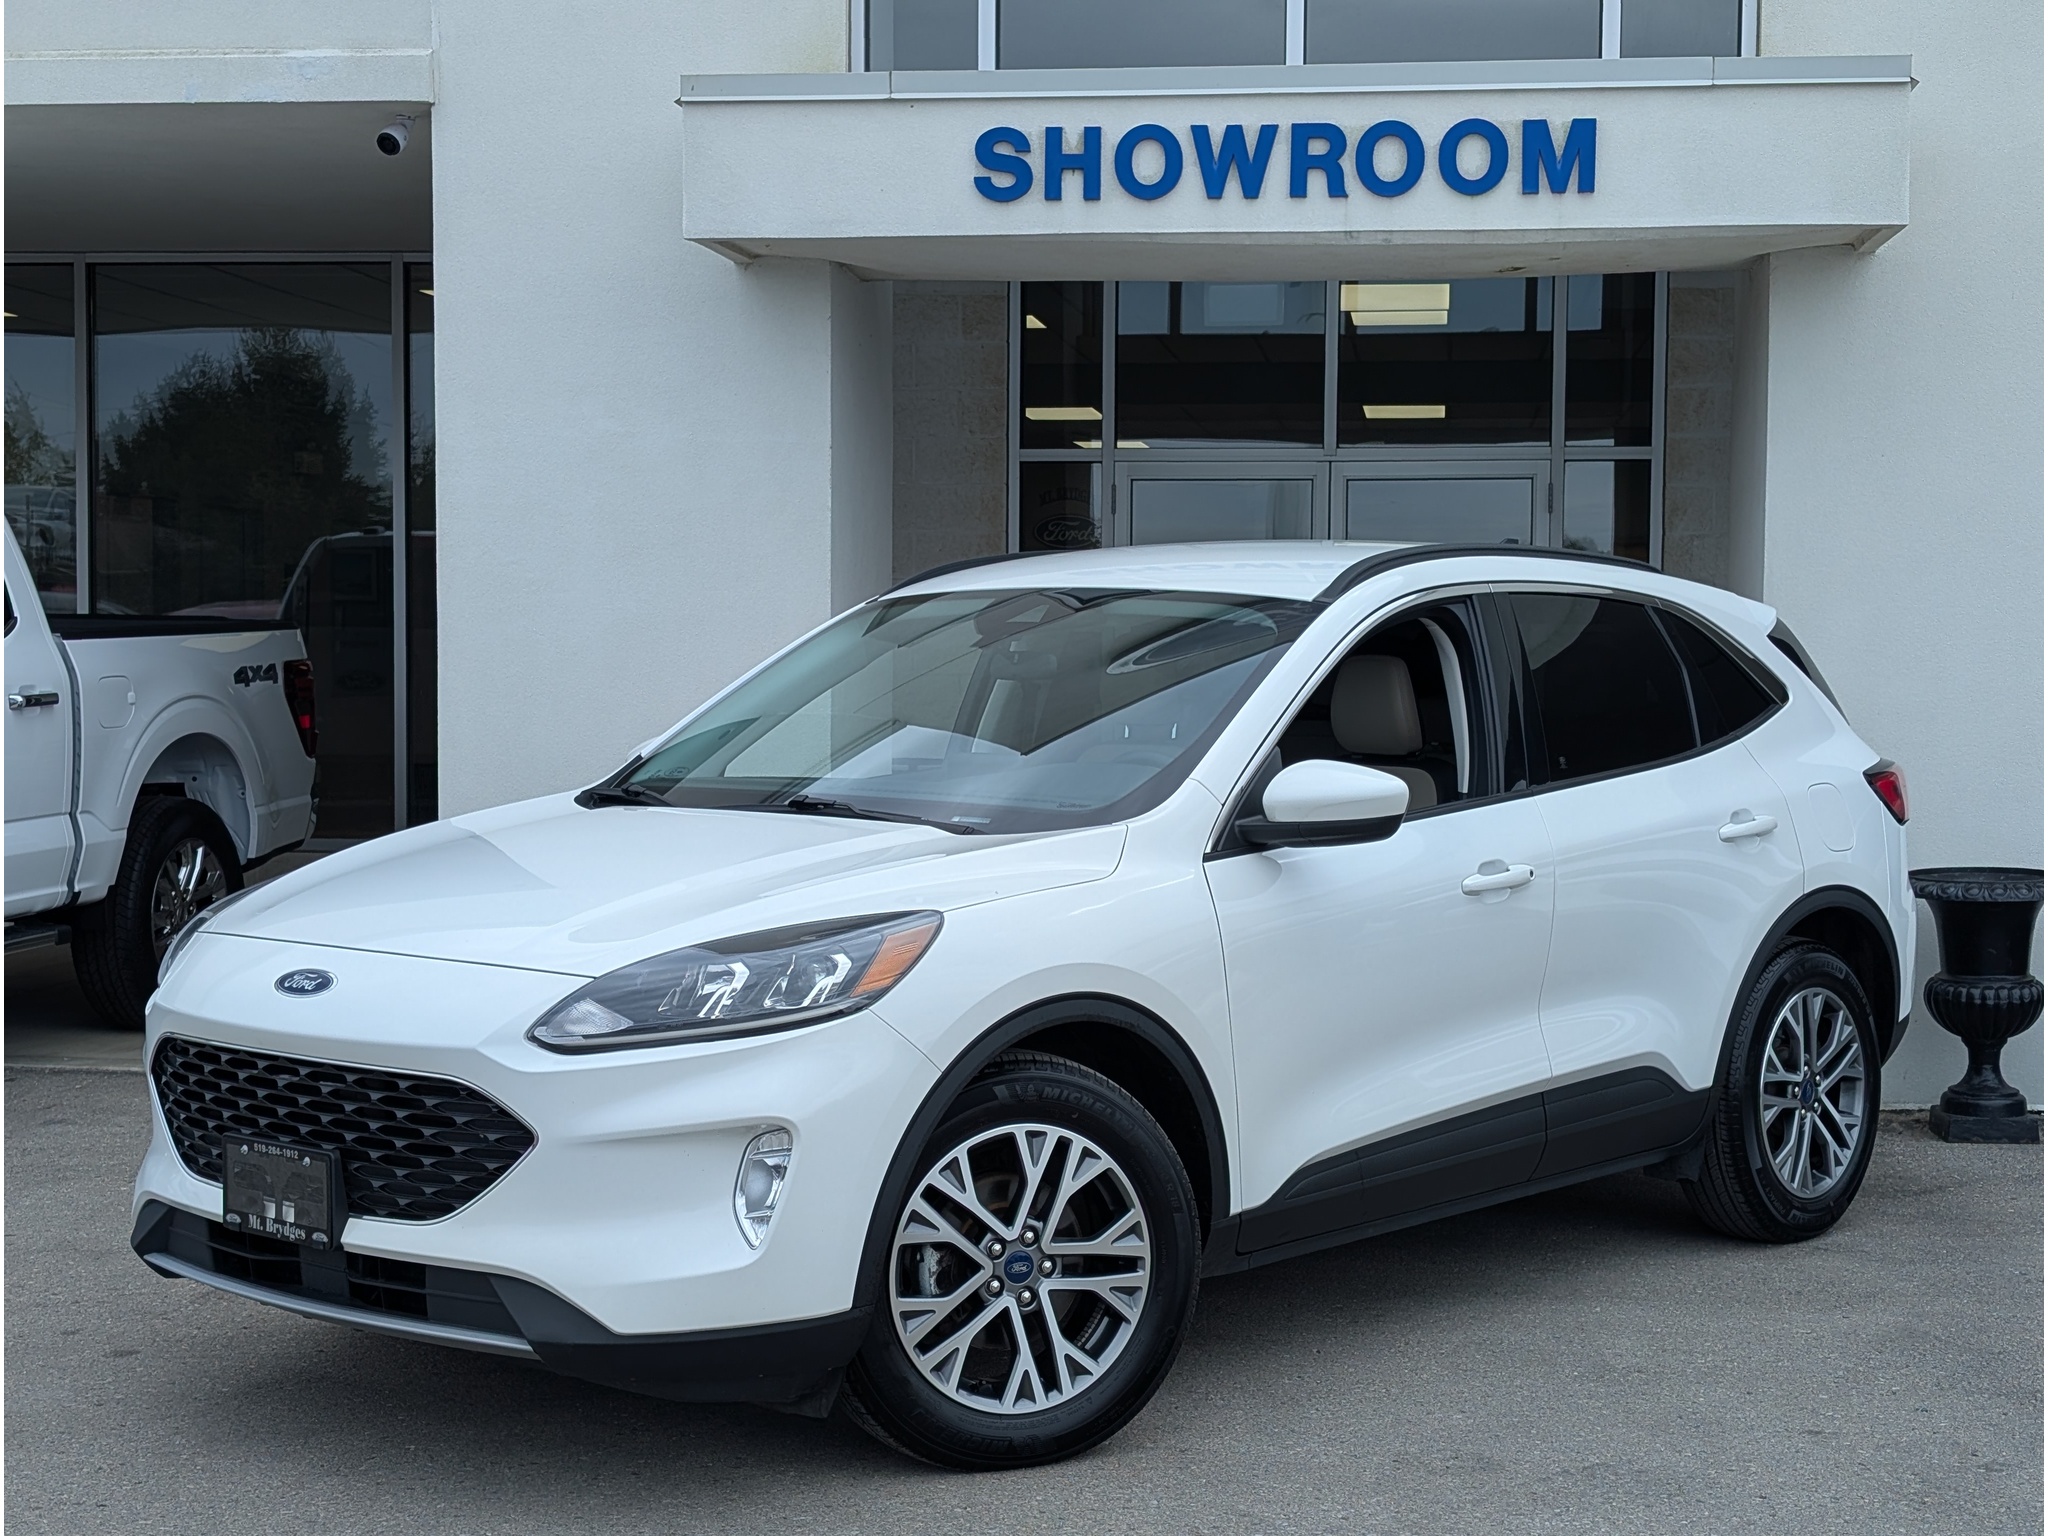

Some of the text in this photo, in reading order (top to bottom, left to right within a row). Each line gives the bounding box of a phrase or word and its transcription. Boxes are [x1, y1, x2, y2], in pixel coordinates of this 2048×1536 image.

[973, 117, 1598, 203] SHOWROOM
[1043, 520, 1095, 542] Ford
[284, 972, 323, 991] Ford
[248, 1213, 306, 1241] Mt. Brydges
